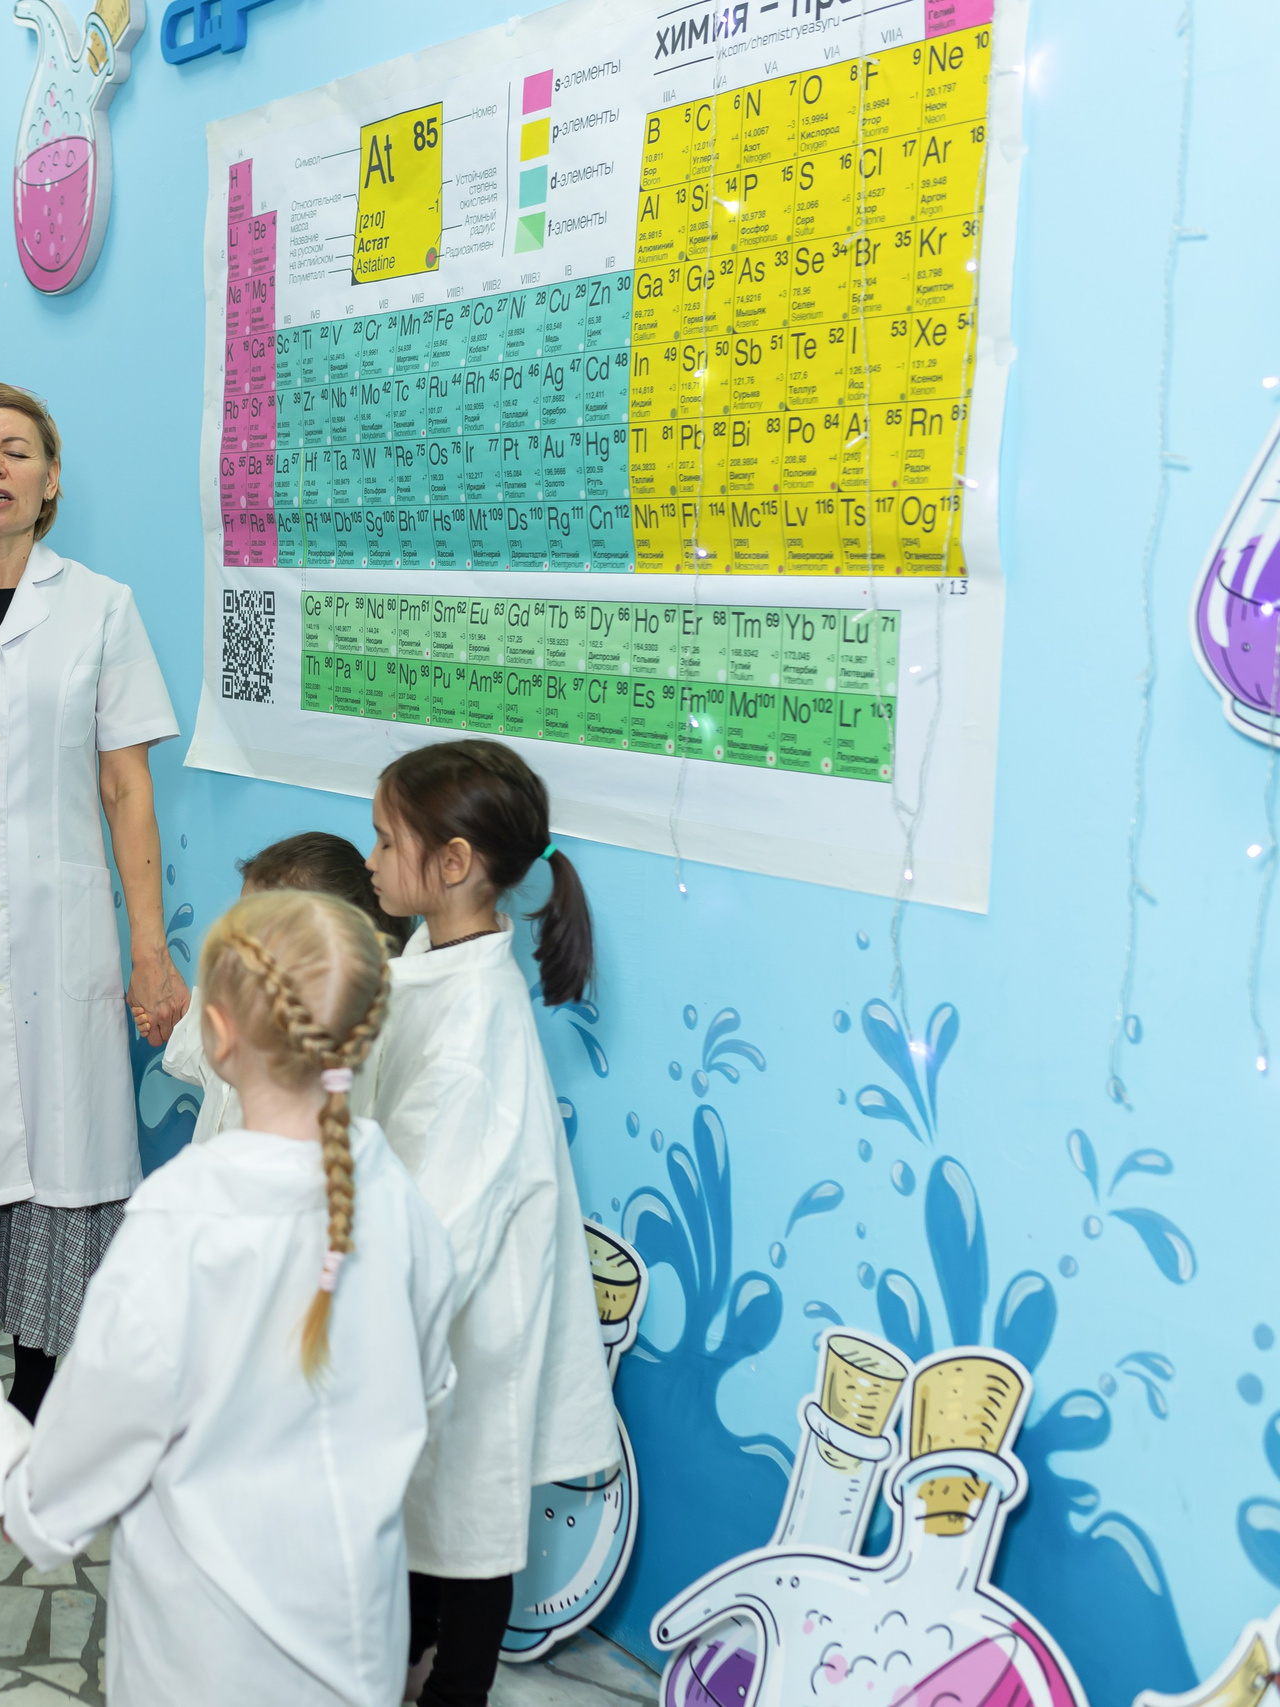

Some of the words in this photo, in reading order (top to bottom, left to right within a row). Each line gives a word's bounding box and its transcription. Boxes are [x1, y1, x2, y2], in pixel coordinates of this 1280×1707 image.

[655, 2, 749, 60] ХИМИЯ
[881, 27, 903, 44] VIIA
[824, 45, 841, 60] VIA
[928, 42, 964, 75] Ne
[974, 30, 989, 49] 10
[554, 59, 620, 92] s-элементы
[764, 61, 778, 74] VA
[865, 59, 880, 91] F
[913, 48, 921, 65] 9
[746, 89, 762, 119] N
[789, 80, 797, 96] 7
[803, 74, 822, 105] O
[850, 65, 858, 82] 8
[472, 104, 497, 120] Номер
[552, 108, 620, 144] p-элементы
[647, 117, 661, 144] B
[684, 108, 691, 123] 5
[696, 103, 711, 132] C
[733, 94, 740, 110] 6
[364, 132, 395, 189] At
[413, 117, 438, 152] 85
[859, 147, 883, 179] Cl
[902, 140, 917, 158] 17
[922, 135, 952, 167] Ar
[970, 125, 985, 144] 18
[295, 156, 320, 169] Символ
[550, 161, 614, 190] d-элементы
[799, 161, 815, 191] S
[839, 153, 852, 170] 16
[230, 169, 239, 190] H
[456, 167, 497, 186] Устойчивая
[469, 180, 497, 195] степень
[744, 173, 758, 202] P
[782, 166, 793, 182] 15
[291, 193, 341, 211] Относительная
[460, 192, 498, 210] окисления
[640, 194, 660, 222] Al
[675, 188, 686, 204] 13
[691, 183, 709, 213] Si
[726, 177, 737, 193] 14
[290, 222, 309, 233] масса
[291, 209, 317, 223] атомная
[358, 209, 385, 233] [210]
[465, 209, 497, 226] Атомный
[470, 221, 496, 238] радиус
[548, 210, 607, 237] f-элементы
[290, 233, 319, 247] Название
[357, 236, 390, 254] Астат
[445, 239, 494, 259] Радиоактивен
[855, 237, 881, 267] Br
[894, 230, 912, 248] 35
[919, 226, 947, 258] Kr
[962, 220, 980, 238] 36
[355, 254, 396, 275] Astatine
[738, 257, 765, 284] As
[774, 250, 788, 266] 33
[795, 247, 825, 276] Se
[832, 241, 848, 258] 34
[289, 270, 325, 285] Полуметалл
[636, 273, 663, 299] Ga
[669, 268, 680, 283] 31
[686, 265, 715, 292] Ge
[720, 259, 734, 275] 32
[229, 285, 241, 305] Na
[549, 288, 571, 314] Cu
[575, 284, 587, 299] 29
[589, 281, 611, 307] Zn
[617, 276, 631, 292] 30
[399, 313, 420, 337] Mn
[423, 310, 433, 324] 25
[473, 302, 493, 326] Co
[497, 298, 508, 312] 27
[365, 319, 382, 342] Cr
[388, 316, 397, 329] 24
[891, 320, 908, 337] 53
[914, 317, 947, 348] Xe
[957, 313, 975, 330] 54
[682, 345, 708, 372] Sn
[715, 340, 729, 356] 50
[735, 338, 762, 367] Sb
[770, 334, 783, 350] 51
[790, 332, 817, 360] Te
[828, 327, 845, 344] 52
[542, 362, 564, 391] Ag
[570, 358, 582, 372] 47
[585, 355, 610, 382] Cd
[615, 352, 628, 368] 48
[633, 352, 649, 377] In
[663, 346, 677, 362] 49
[788, 416, 815, 444] Po
[824, 413, 839, 430] 84
[885, 409, 902, 426] 85
[909, 408, 943, 437] Rn
[631, 427, 647, 453] Tl
[662, 425, 673, 440] 81
[681, 424, 705, 450] Pb
[713, 421, 726, 437] 82
[732, 420, 750, 448] Bi
[766, 417, 781, 433] 83
[634, 504, 659, 529] Nh
[660, 503, 676, 518] 113
[709, 501, 725, 516] 114
[731, 501, 761, 528] Mc
[760, 500, 778, 516] 115
[785, 500, 808, 527] Lv
[815, 498, 834, 515] 116
[840, 498, 866, 526] Ts
[875, 497, 895, 513] 117
[901, 496, 937, 533] Og
[634, 607, 660, 634] Ho
[784, 612, 815, 642] Yb
[366, 658, 376, 682] U
